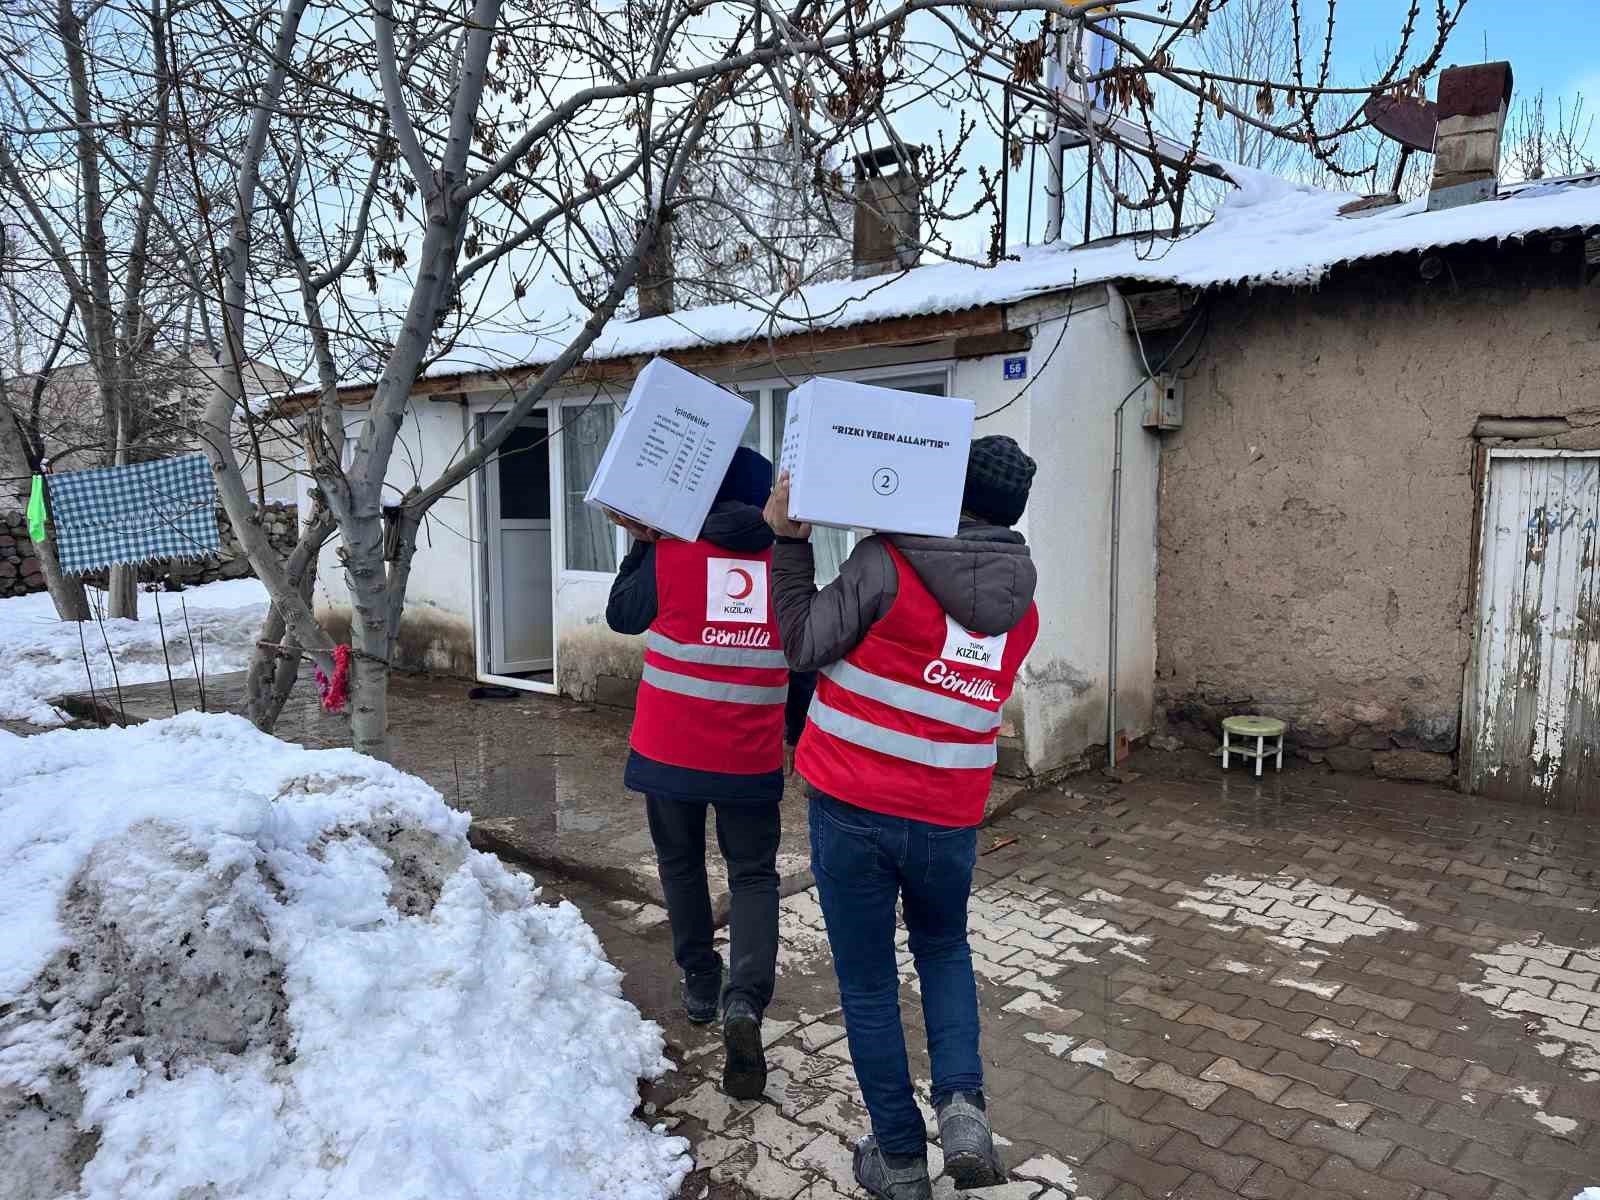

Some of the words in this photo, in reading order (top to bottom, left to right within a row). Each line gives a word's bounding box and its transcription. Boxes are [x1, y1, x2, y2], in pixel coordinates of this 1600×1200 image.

[1009, 364, 1022, 374] 56
[832, 425, 865, 438] "RIZKI
[866, 430, 896, 442] VEREN
[881, 475, 890, 488] 2
[724, 606, 753, 615] KIZILAY
[702, 627, 771, 647] Gönüllü
[956, 647, 992, 663] KIZILAY
